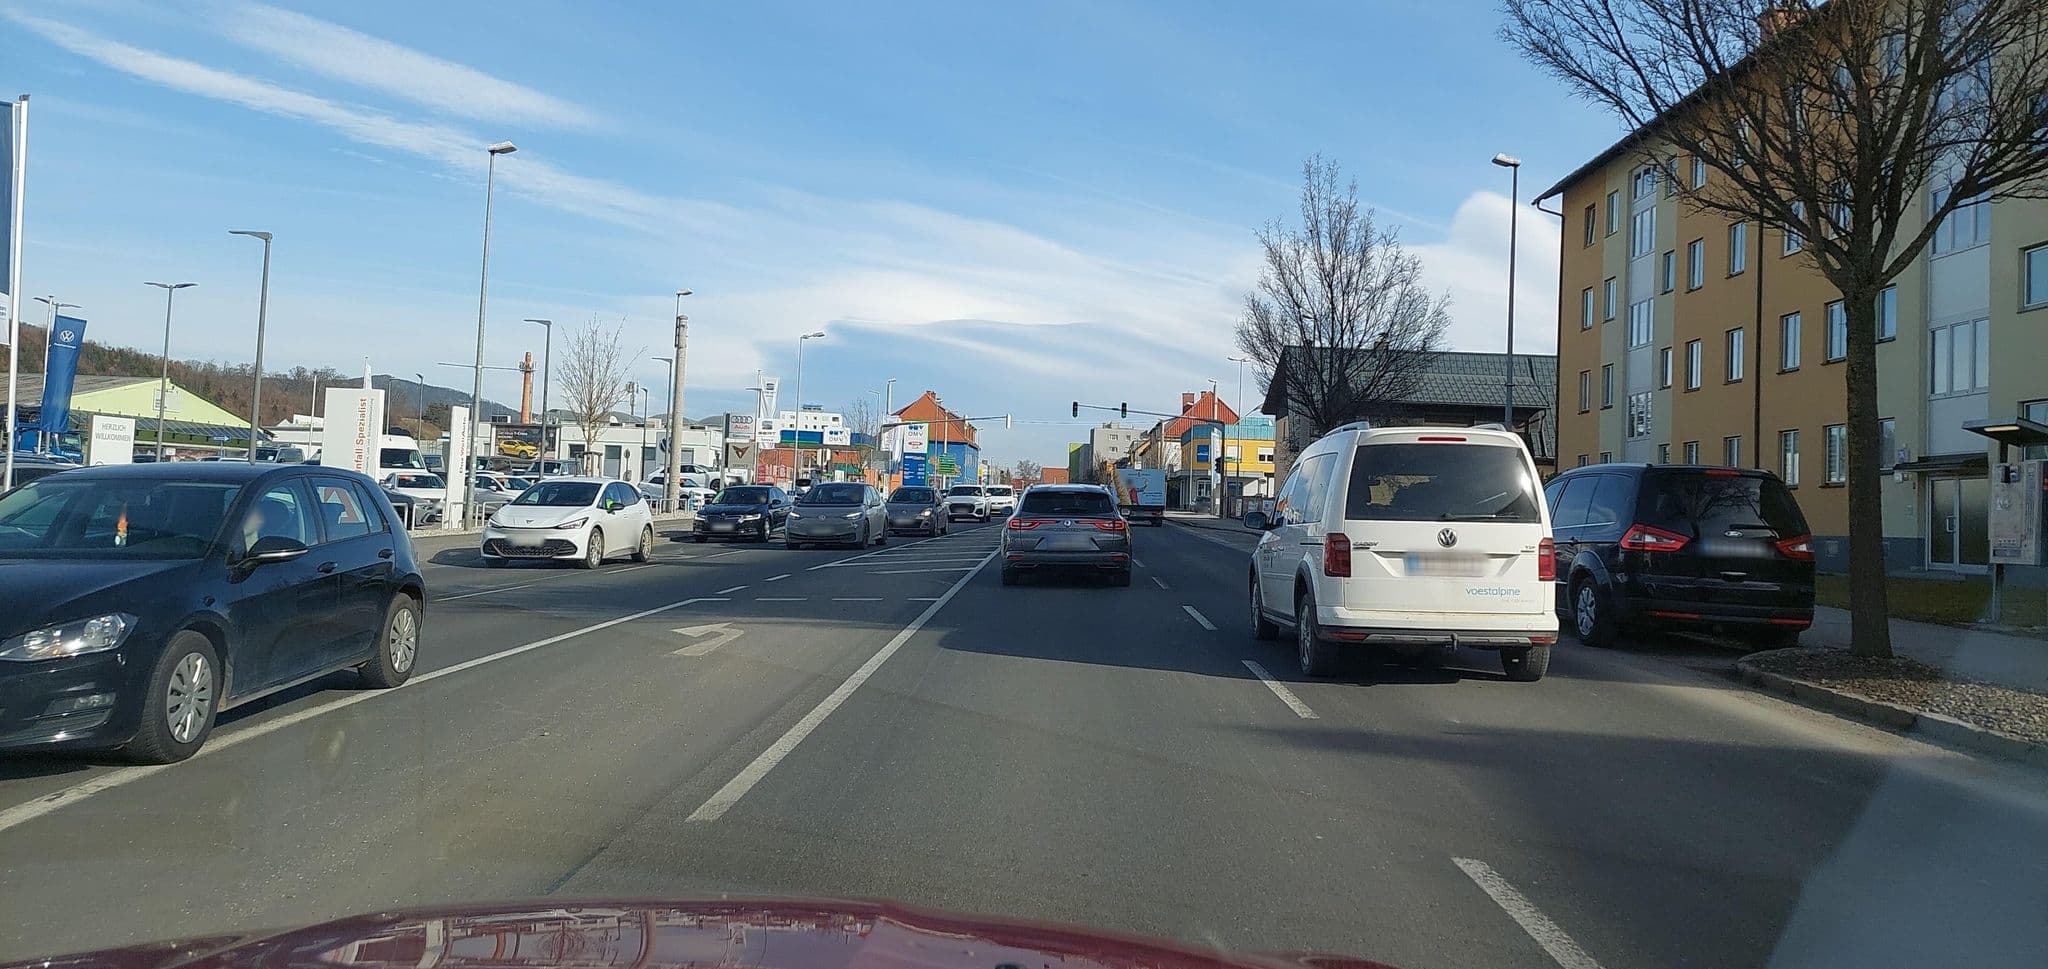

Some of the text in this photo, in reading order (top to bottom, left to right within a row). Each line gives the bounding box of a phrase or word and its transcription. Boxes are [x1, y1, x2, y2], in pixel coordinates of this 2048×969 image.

[356, 398, 367, 445] Spezialist
[102, 423, 126, 431] HERZLICH
[95, 432, 131, 441] WILLKOMMEN
[1466, 587, 1521, 598] voestalpine
